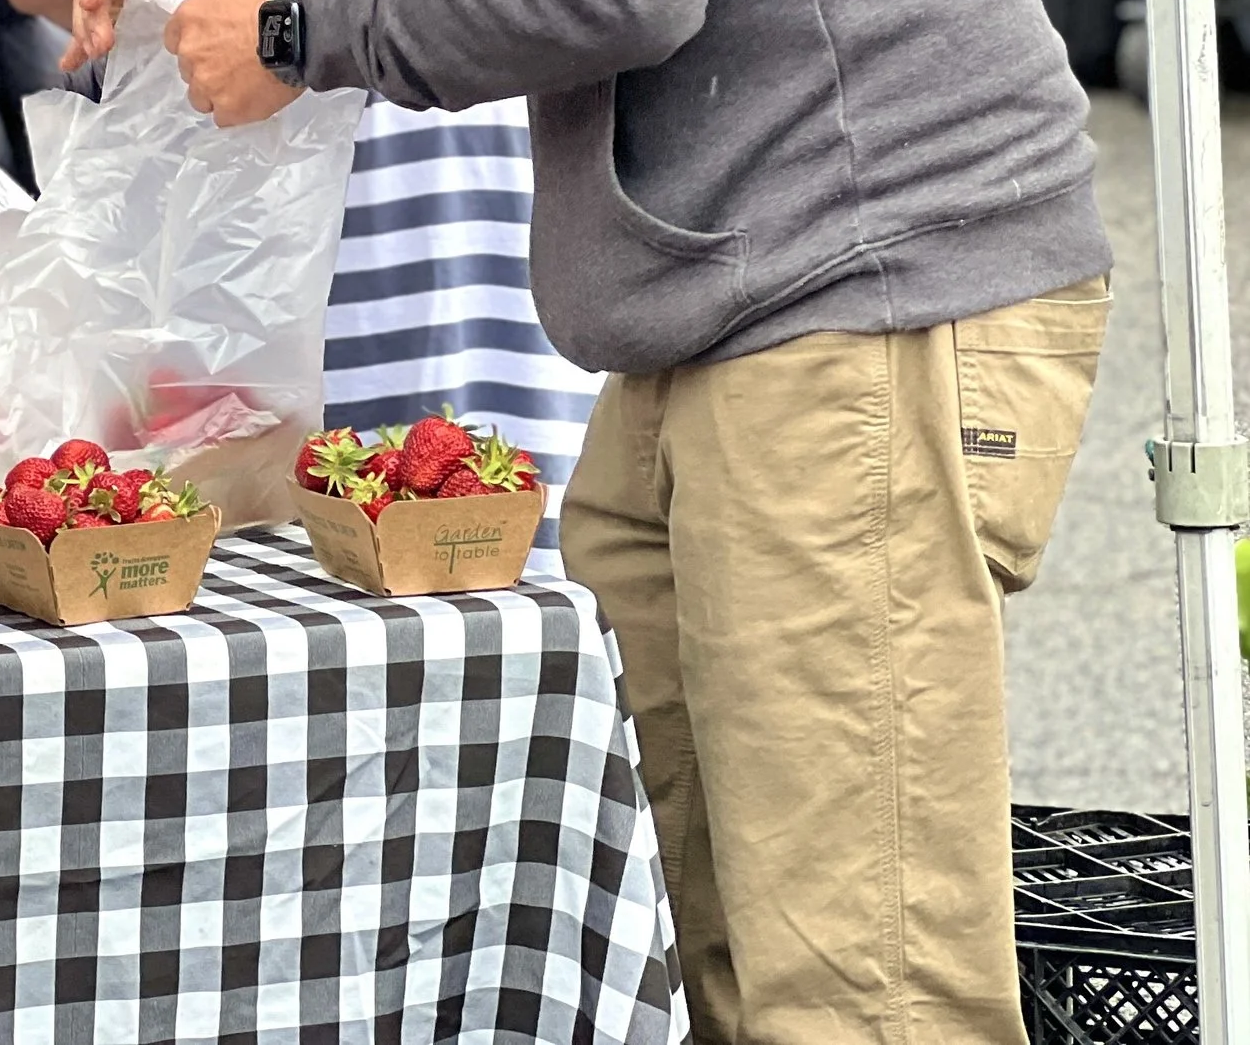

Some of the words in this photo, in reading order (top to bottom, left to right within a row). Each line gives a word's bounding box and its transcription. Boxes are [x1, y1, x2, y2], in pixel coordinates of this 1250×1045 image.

[978, 432, 1014, 444] ARIAT
[434, 523, 502, 544] Garden
[121, 561, 169, 579] more
[119, 576, 168, 590] matters
